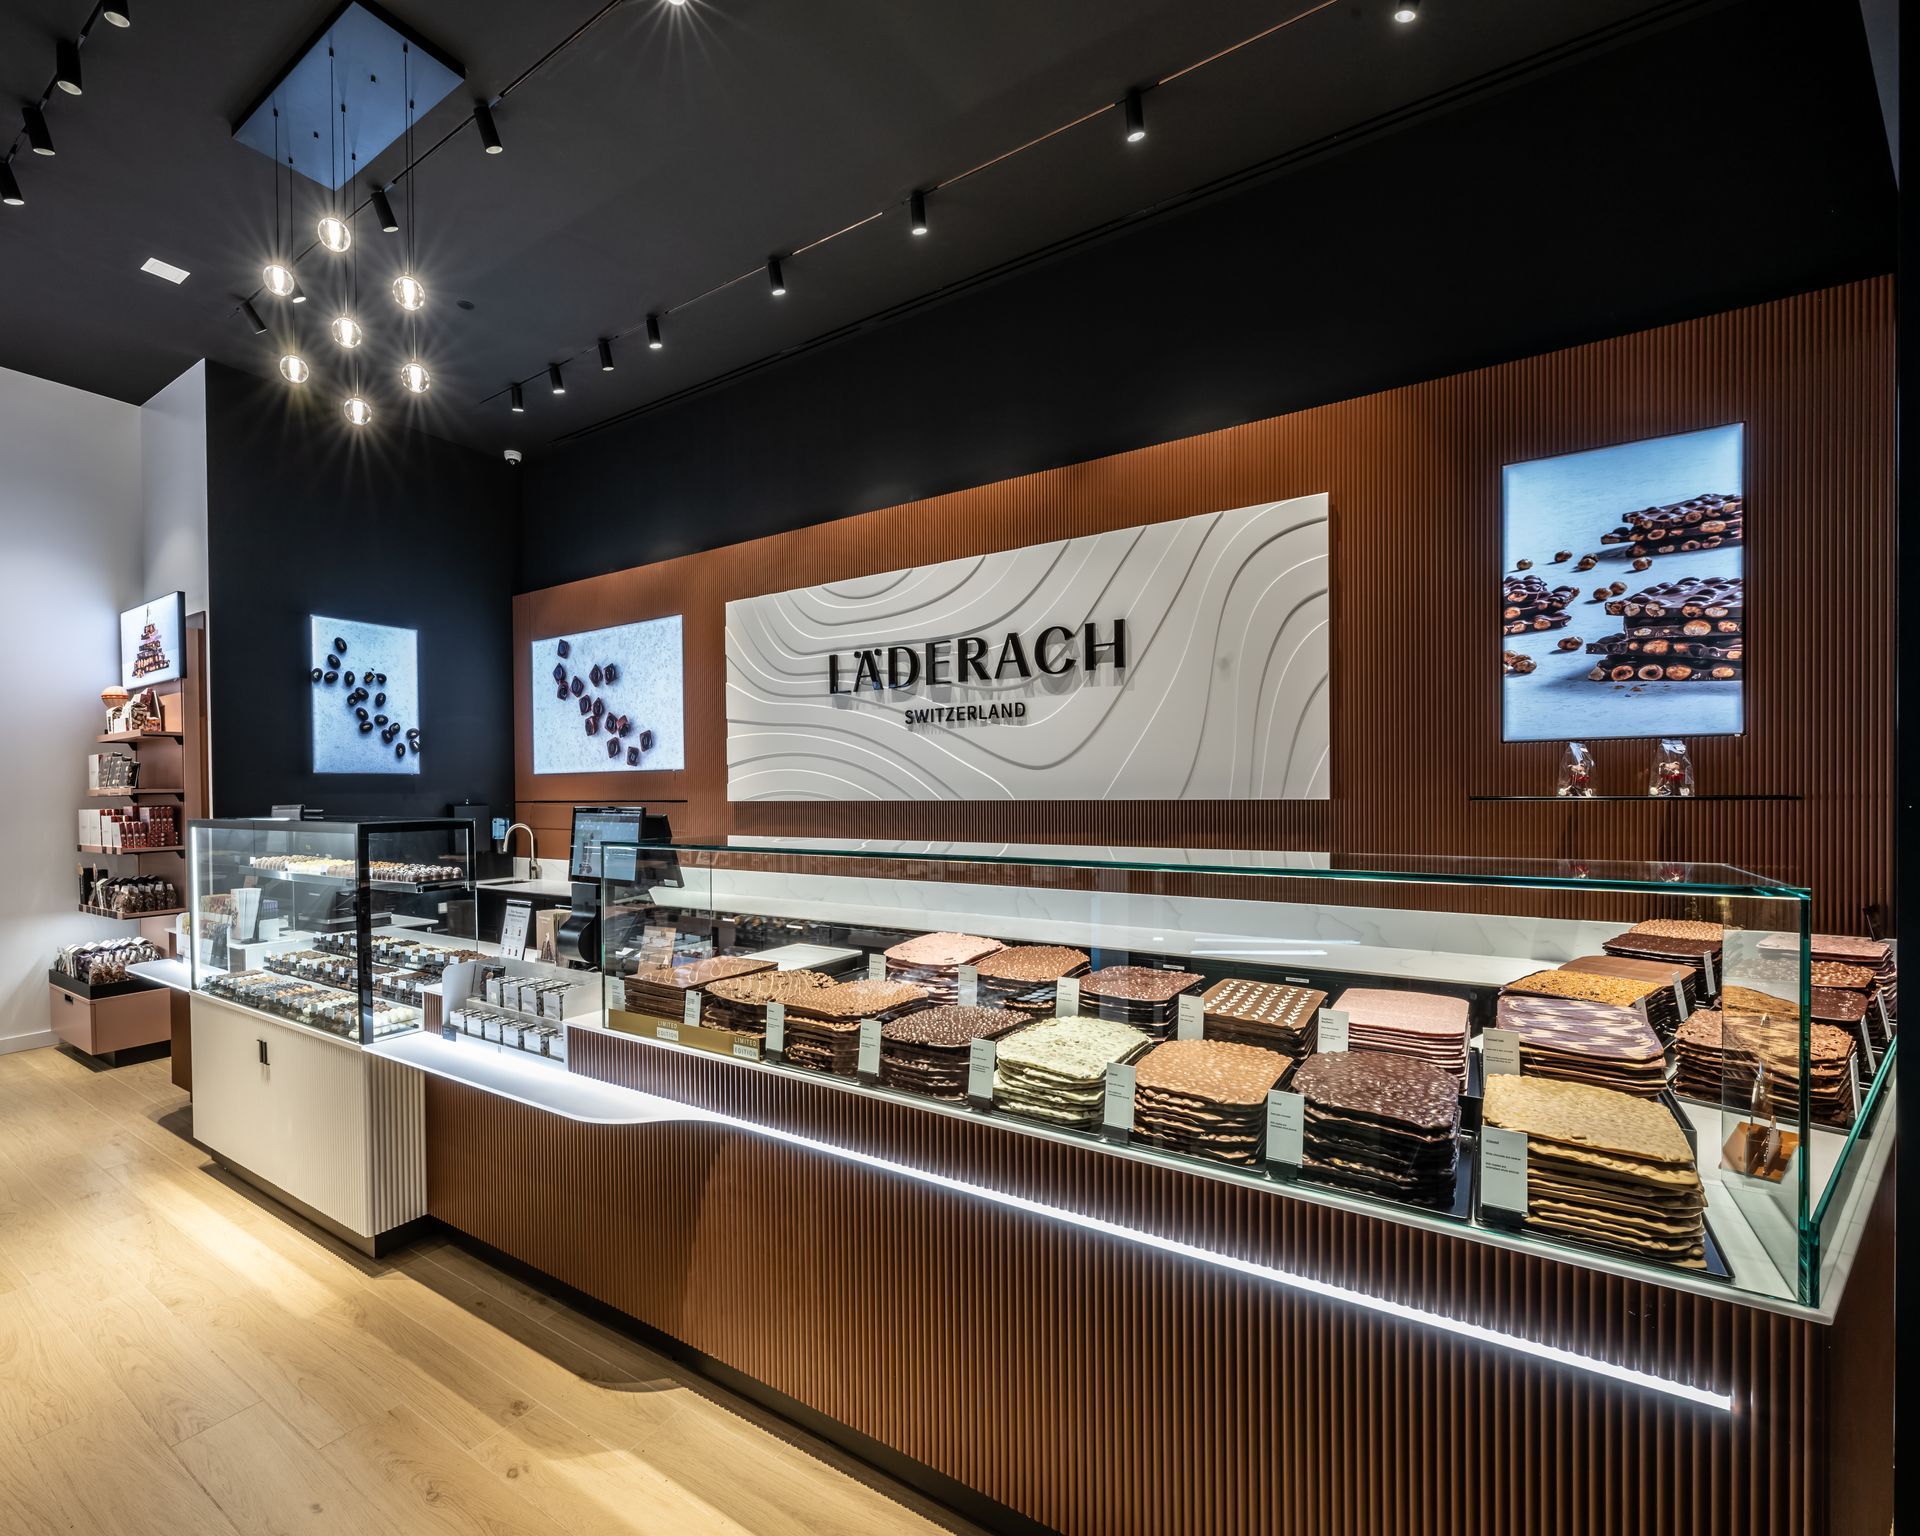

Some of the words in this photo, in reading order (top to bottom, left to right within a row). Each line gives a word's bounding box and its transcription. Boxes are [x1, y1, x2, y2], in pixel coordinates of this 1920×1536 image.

[829, 618, 1126, 694] LÄDERACH
[904, 701, 1027, 725] SWITZERLAND
[657, 1020, 678, 1029] LIMITED
[657, 1029, 678, 1039] EDITION
[734, 1037, 757, 1047] LIMITED
[734, 1046, 757, 1057] EDITION
